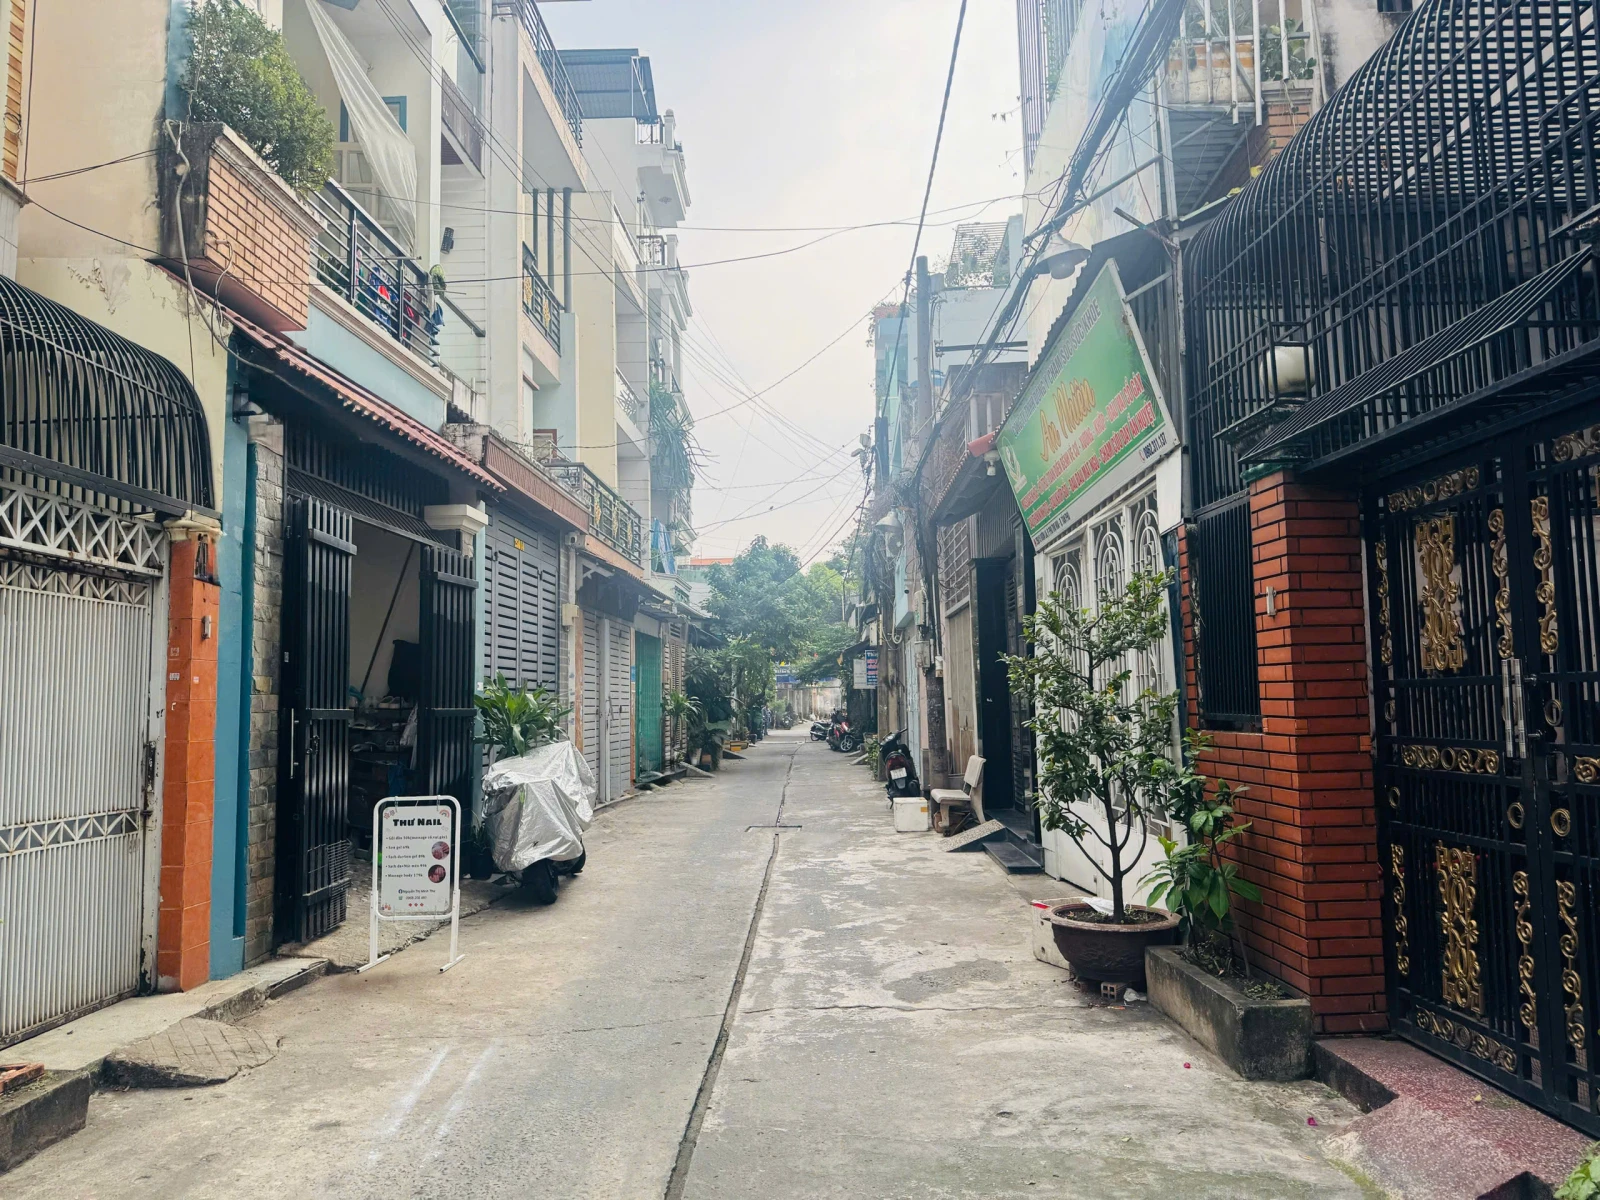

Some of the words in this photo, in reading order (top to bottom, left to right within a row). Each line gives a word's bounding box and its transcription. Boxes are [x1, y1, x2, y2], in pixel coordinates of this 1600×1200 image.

[1040, 409, 1061, 461] An
[1053, 377, 1096, 439] Nhiên
[418, 818, 442, 826] NAIL
